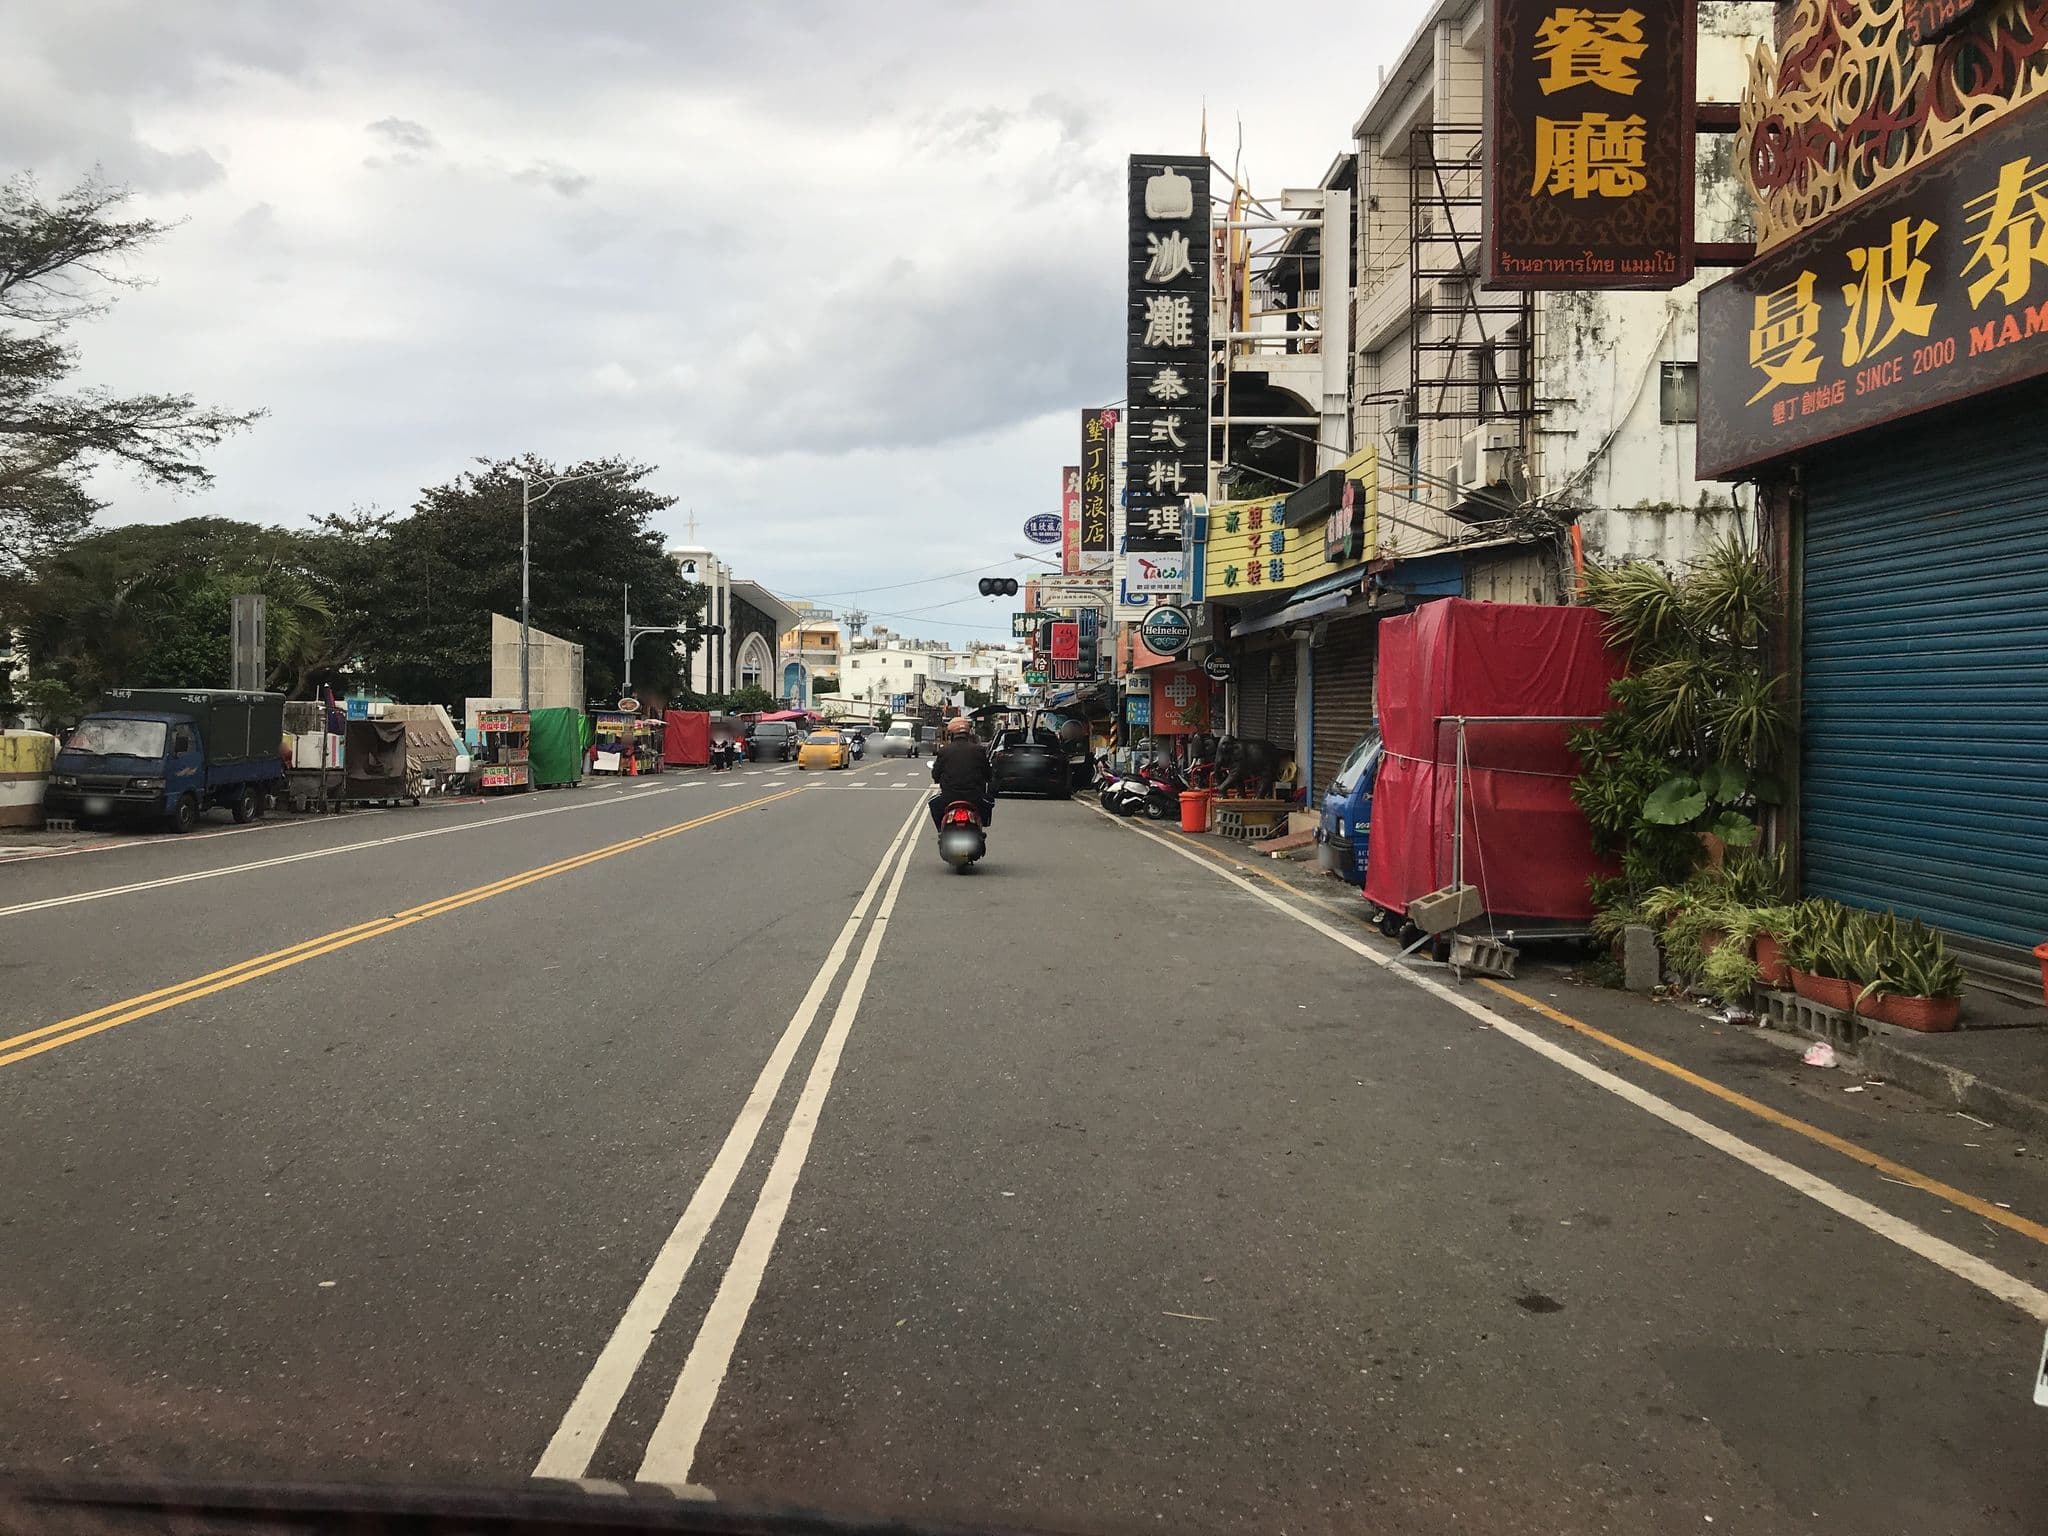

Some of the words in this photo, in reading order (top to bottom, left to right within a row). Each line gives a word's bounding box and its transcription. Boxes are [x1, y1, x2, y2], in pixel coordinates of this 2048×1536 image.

[1530, 7, 1649, 199] 餐廳
[1501, 250, 1614, 273] ร้านอาหารไทย
[1745, 156, 2048, 407] 曼波泰
[1143, 165, 1194, 535] 白沙灘泰式料理
[1771, 379, 1846, 426] 墾丁創始店
[1855, 356, 1903, 396] SINCE
[1912, 337, 1956, 377] 2000
[1083, 417, 1107, 544] 墾丁衝浪店
[1145, 626, 1188, 635] Heineken
